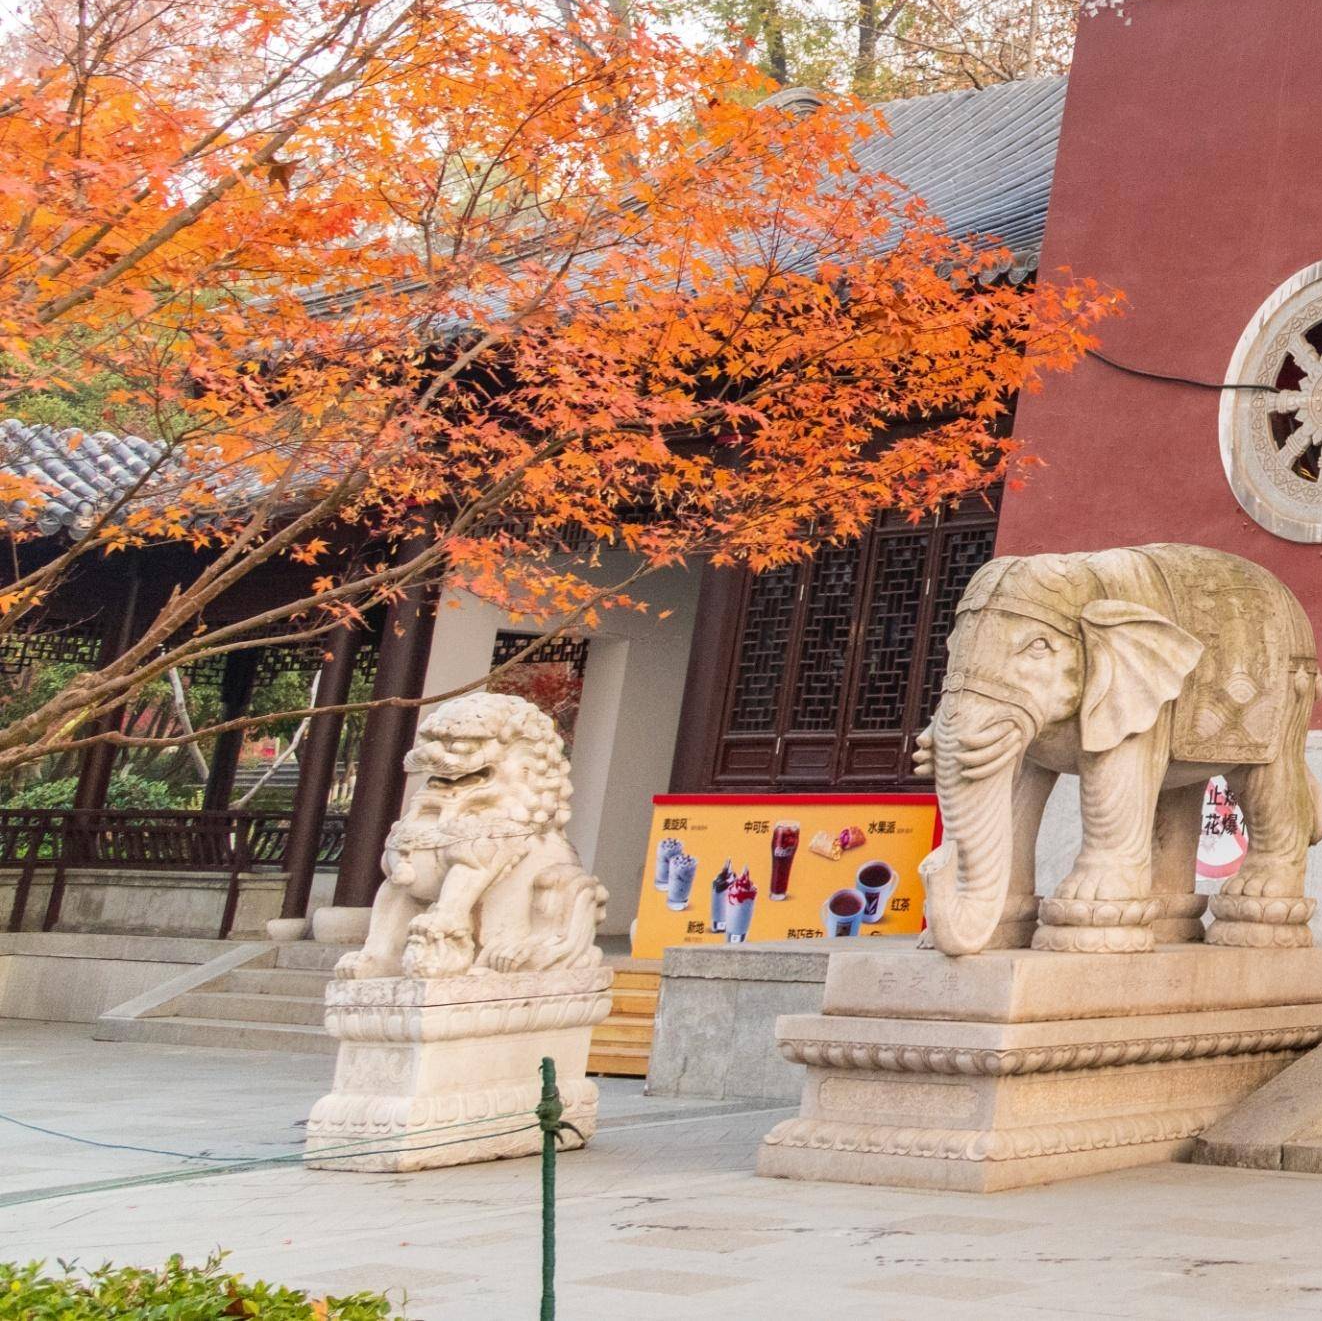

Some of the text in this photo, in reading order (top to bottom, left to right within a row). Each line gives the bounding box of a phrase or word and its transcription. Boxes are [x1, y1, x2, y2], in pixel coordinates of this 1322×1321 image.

[663, 818, 688, 831] 麦旋风
[744, 821, 770, 834] 中可乐
[867, 821, 897, 834] 水果派
[891, 898, 910, 912] 红茶
[687, 921, 705, 934] 新地
